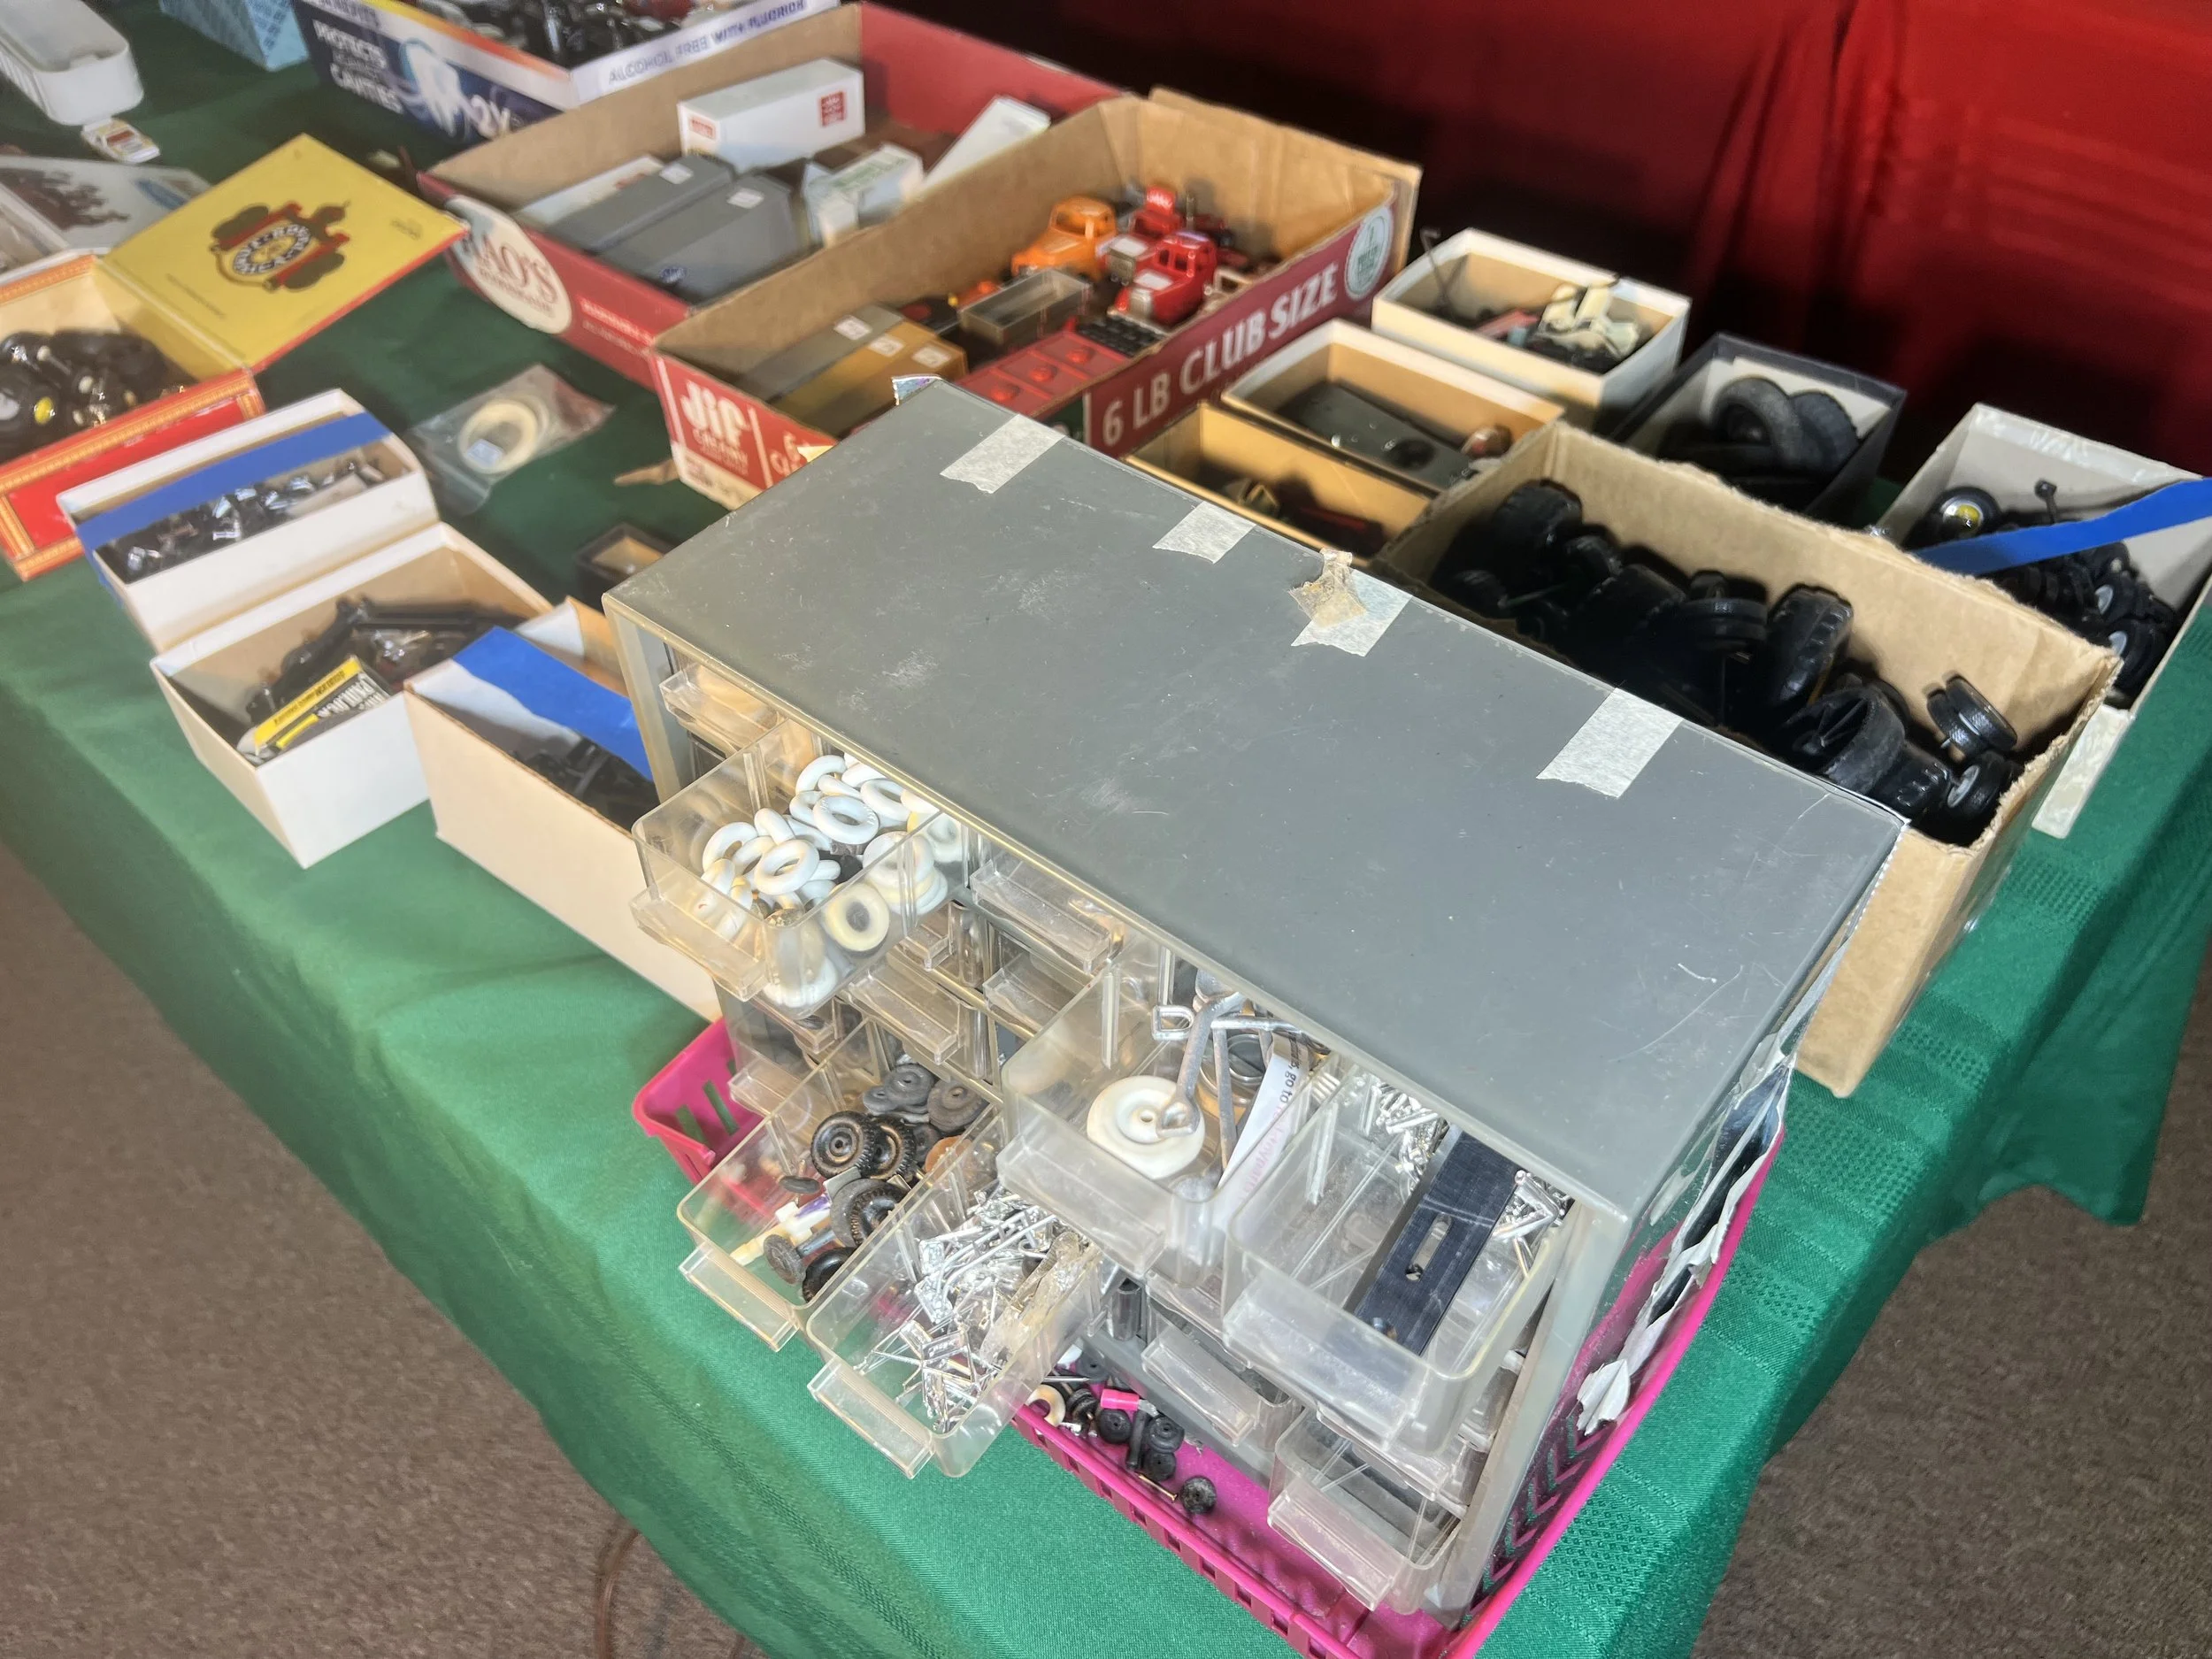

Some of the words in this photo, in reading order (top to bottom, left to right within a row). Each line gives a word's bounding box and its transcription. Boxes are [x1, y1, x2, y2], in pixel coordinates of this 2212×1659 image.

[609, 50, 673, 85] ALCOHOL
[1102, 400, 1124, 446] 6
[1133, 372, 1171, 431] LB
[1179, 311, 1267, 395] CLUB
[1268, 263, 1340, 340] SIZE
[1285, 1071, 1297, 1087] go
[1279, 1091, 1293, 1104] to
